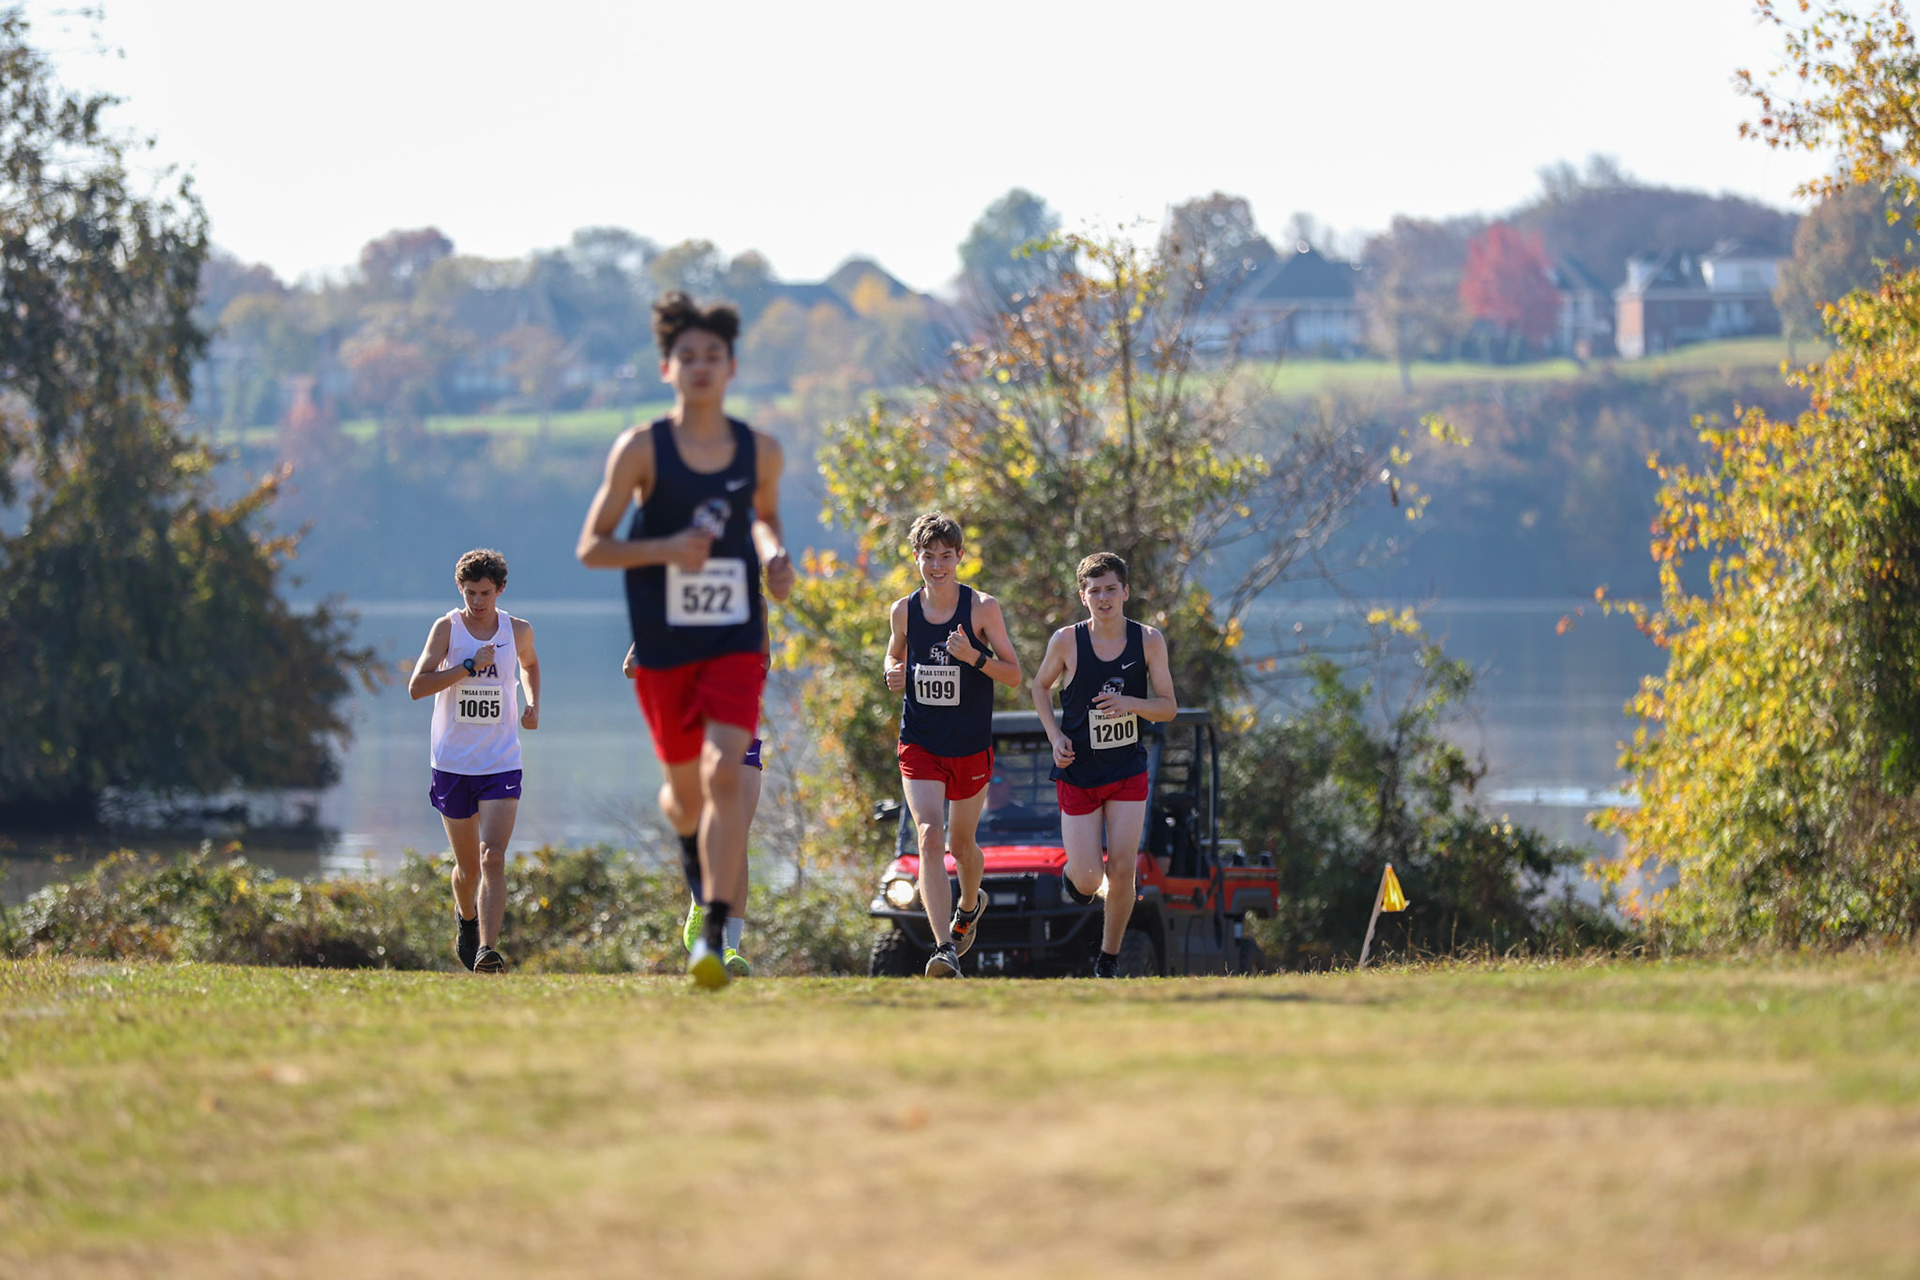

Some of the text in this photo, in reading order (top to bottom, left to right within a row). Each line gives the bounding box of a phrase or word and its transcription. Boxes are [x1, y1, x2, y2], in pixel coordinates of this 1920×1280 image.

[682, 585, 732, 614] 522
[917, 680, 955, 699] 1199
[459, 700, 500, 718] 1065
[1093, 720, 1134, 743] 1200
